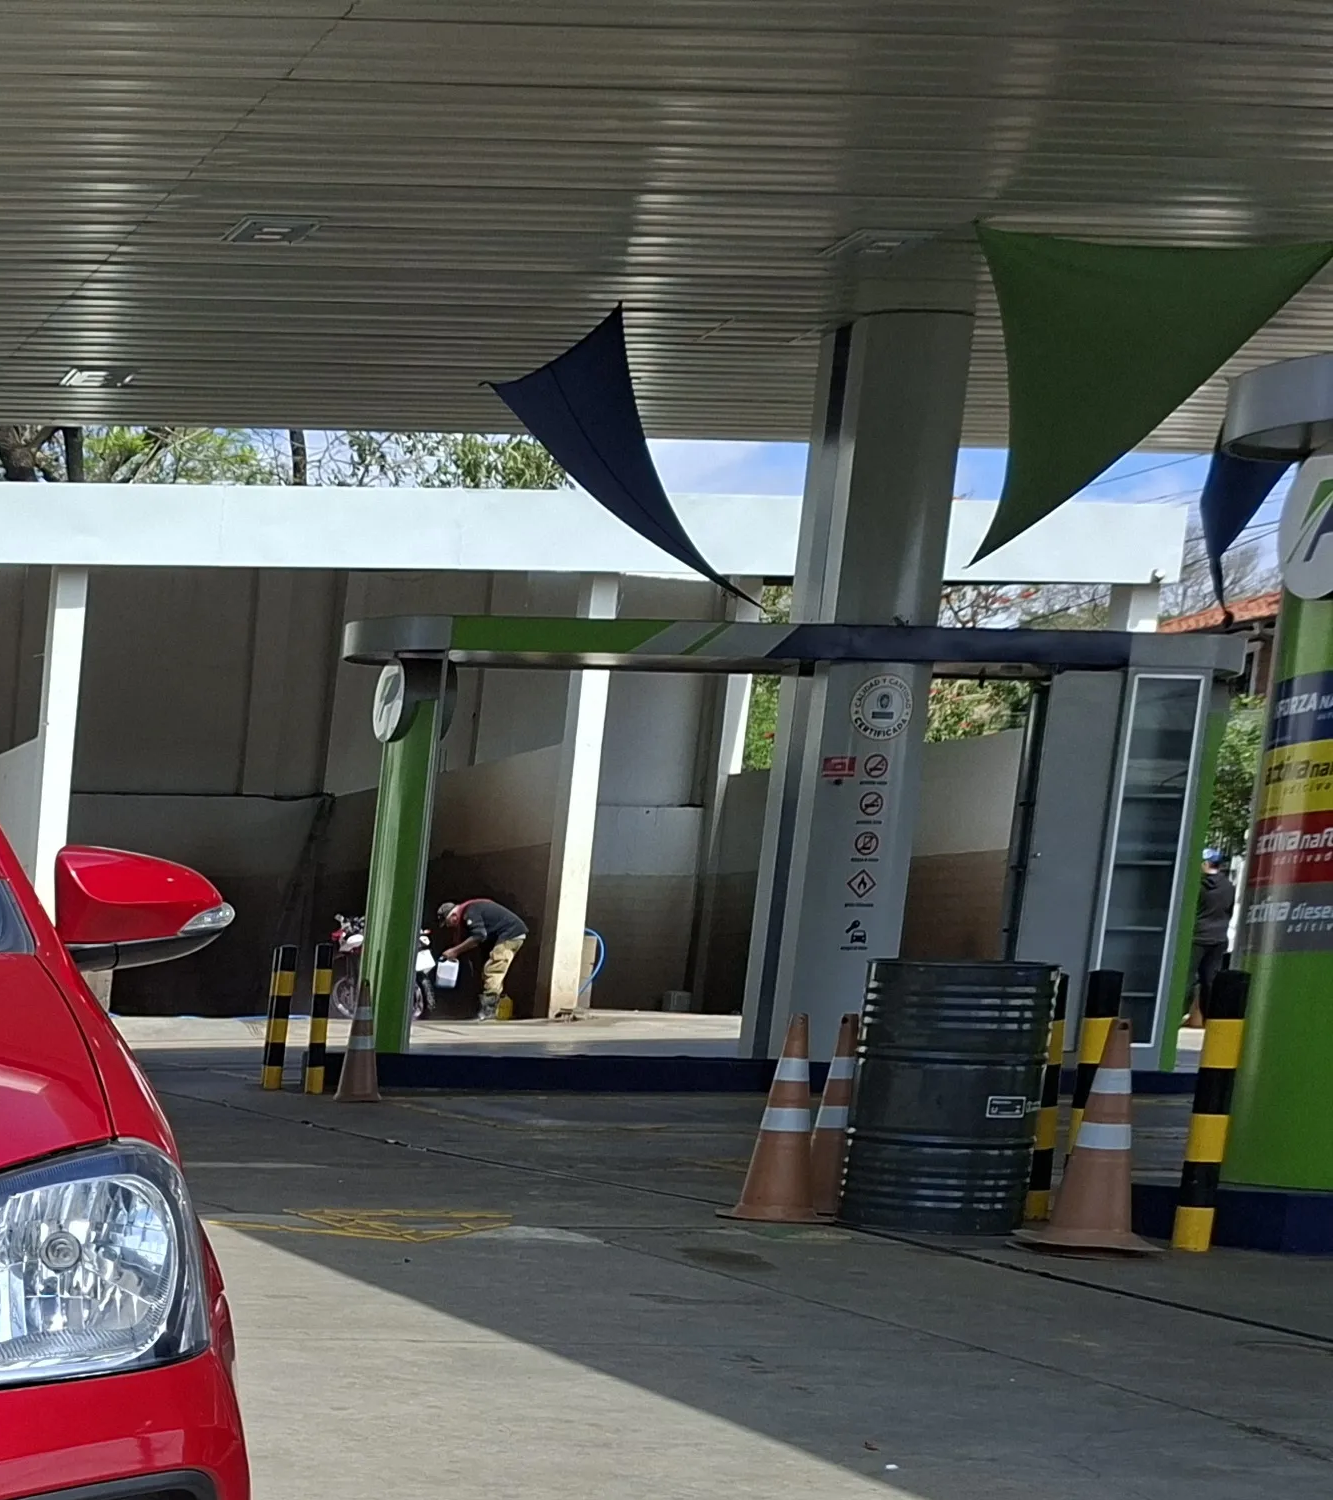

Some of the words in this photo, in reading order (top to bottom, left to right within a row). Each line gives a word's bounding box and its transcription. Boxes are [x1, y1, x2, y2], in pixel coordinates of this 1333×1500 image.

[855, 679, 881, 708] CALIDAD
[1276, 692, 1318, 717] FORZA
[854, 717, 908, 738] CERTIFICADA
[1290, 902, 1333, 920] diese
